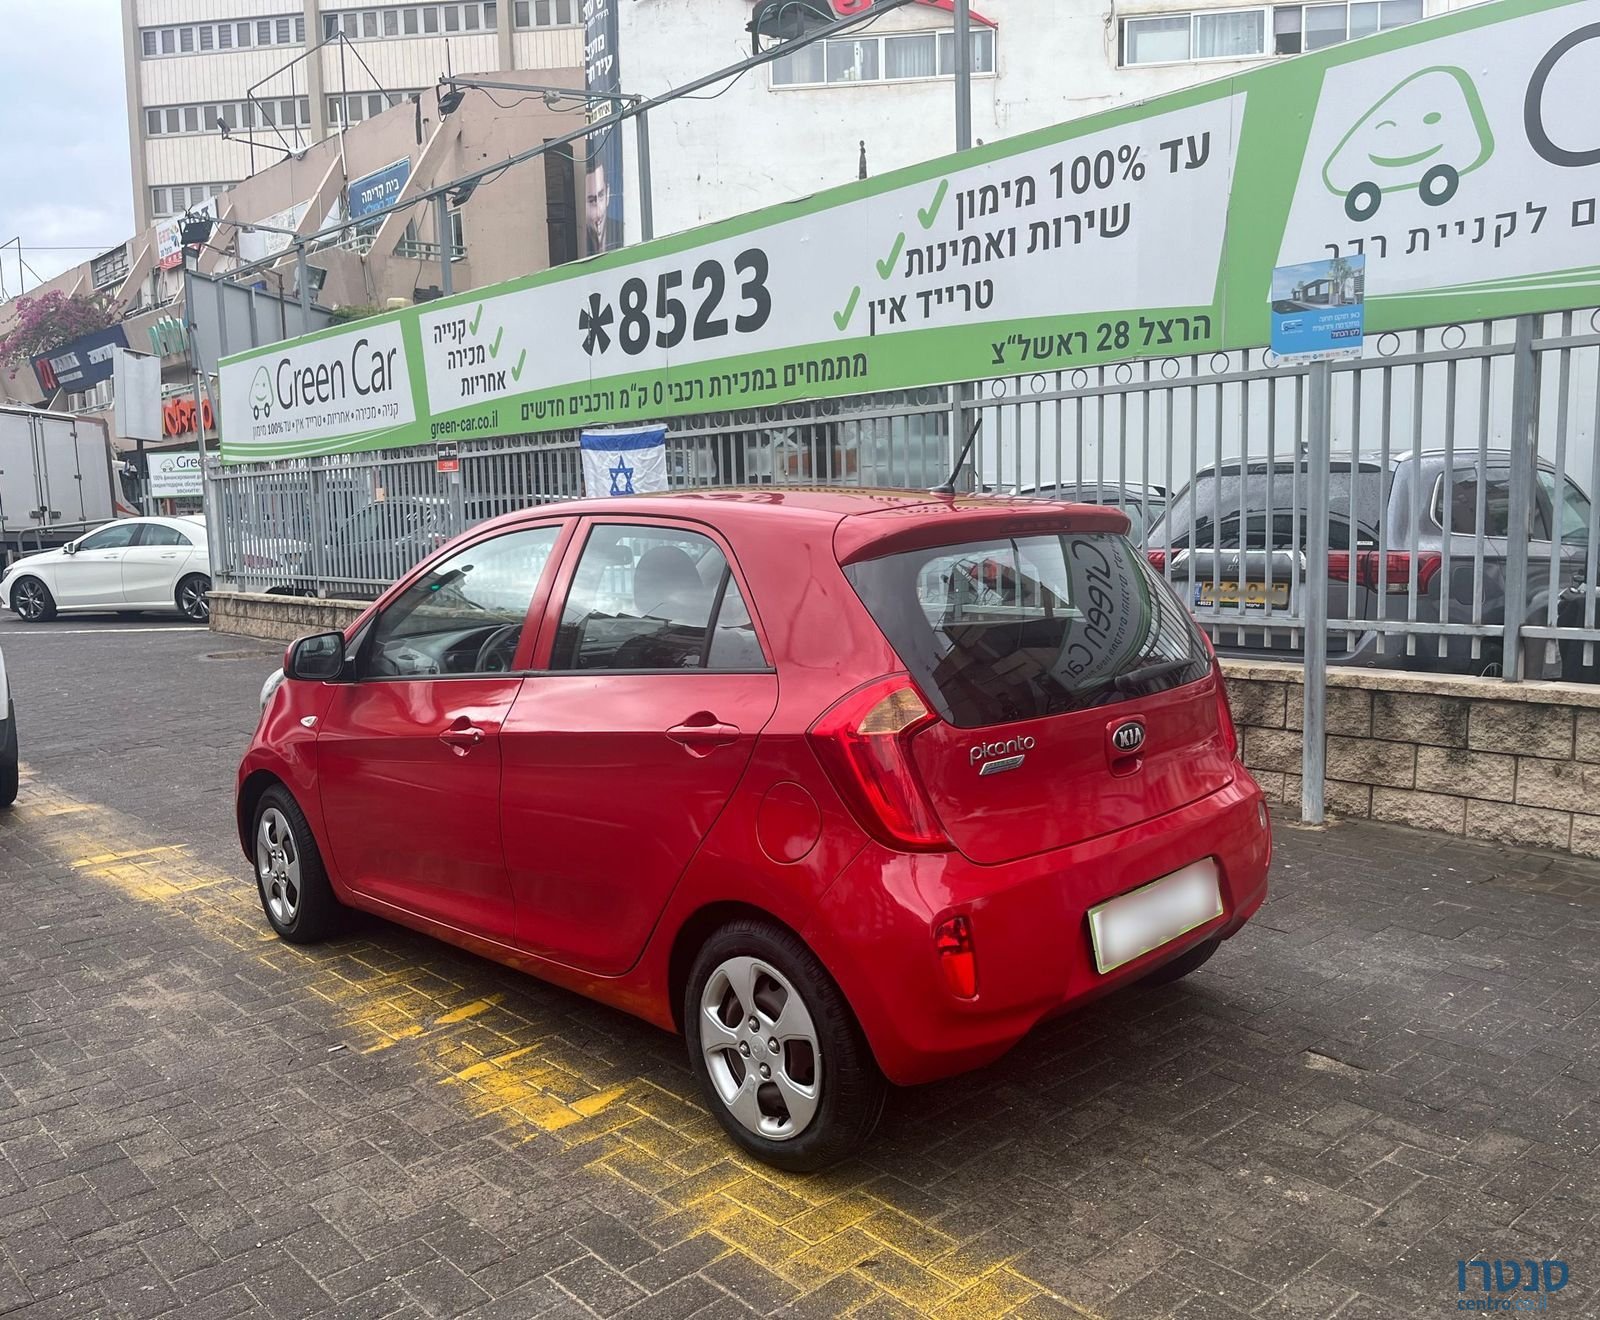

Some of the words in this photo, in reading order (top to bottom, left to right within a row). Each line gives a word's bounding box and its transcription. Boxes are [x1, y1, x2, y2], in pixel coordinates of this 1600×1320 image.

[1160, 132, 1211, 174] עד
[385, 178, 400, 194] בית
[1050, 144, 1146, 199] 100%
[956, 175, 1036, 231] מימון
[1027, 202, 1131, 254] שירות
[1406, 201, 1547, 254] לקניית
[905, 227, 1016, 278] ואמינות
[916, 278, 994, 319] טרייד
[868, 294, 907, 336] אין
[1139, 314, 1211, 346] הרצל
[434, 319, 466, 344] קנייה
[1096, 321, 1130, 352] 28
[448, 344, 486, 369] מכירה
[783, 352, 868, 387] מתמחים
[276, 358, 346, 410] Green
[352, 338, 396, 396] Car
[461, 370, 507, 396] אחריות
[708, 367, 777, 397] במכירת
[569, 391, 614, 415] ורכבים
[653, 381, 663, 405] 0
[667, 380, 703, 402] רכבי
[327, 410, 350, 426] אחריות
[355, 406, 377, 420] מכירה
[382, 402, 399, 419] קניה
[431, 409, 498, 439] green-car.co.il
[521, 397, 565, 421] חדשים
[268, 421, 283, 434] 100%
[970, 735, 1036, 767] picanto
[1118, 728, 1142, 748] KIA
